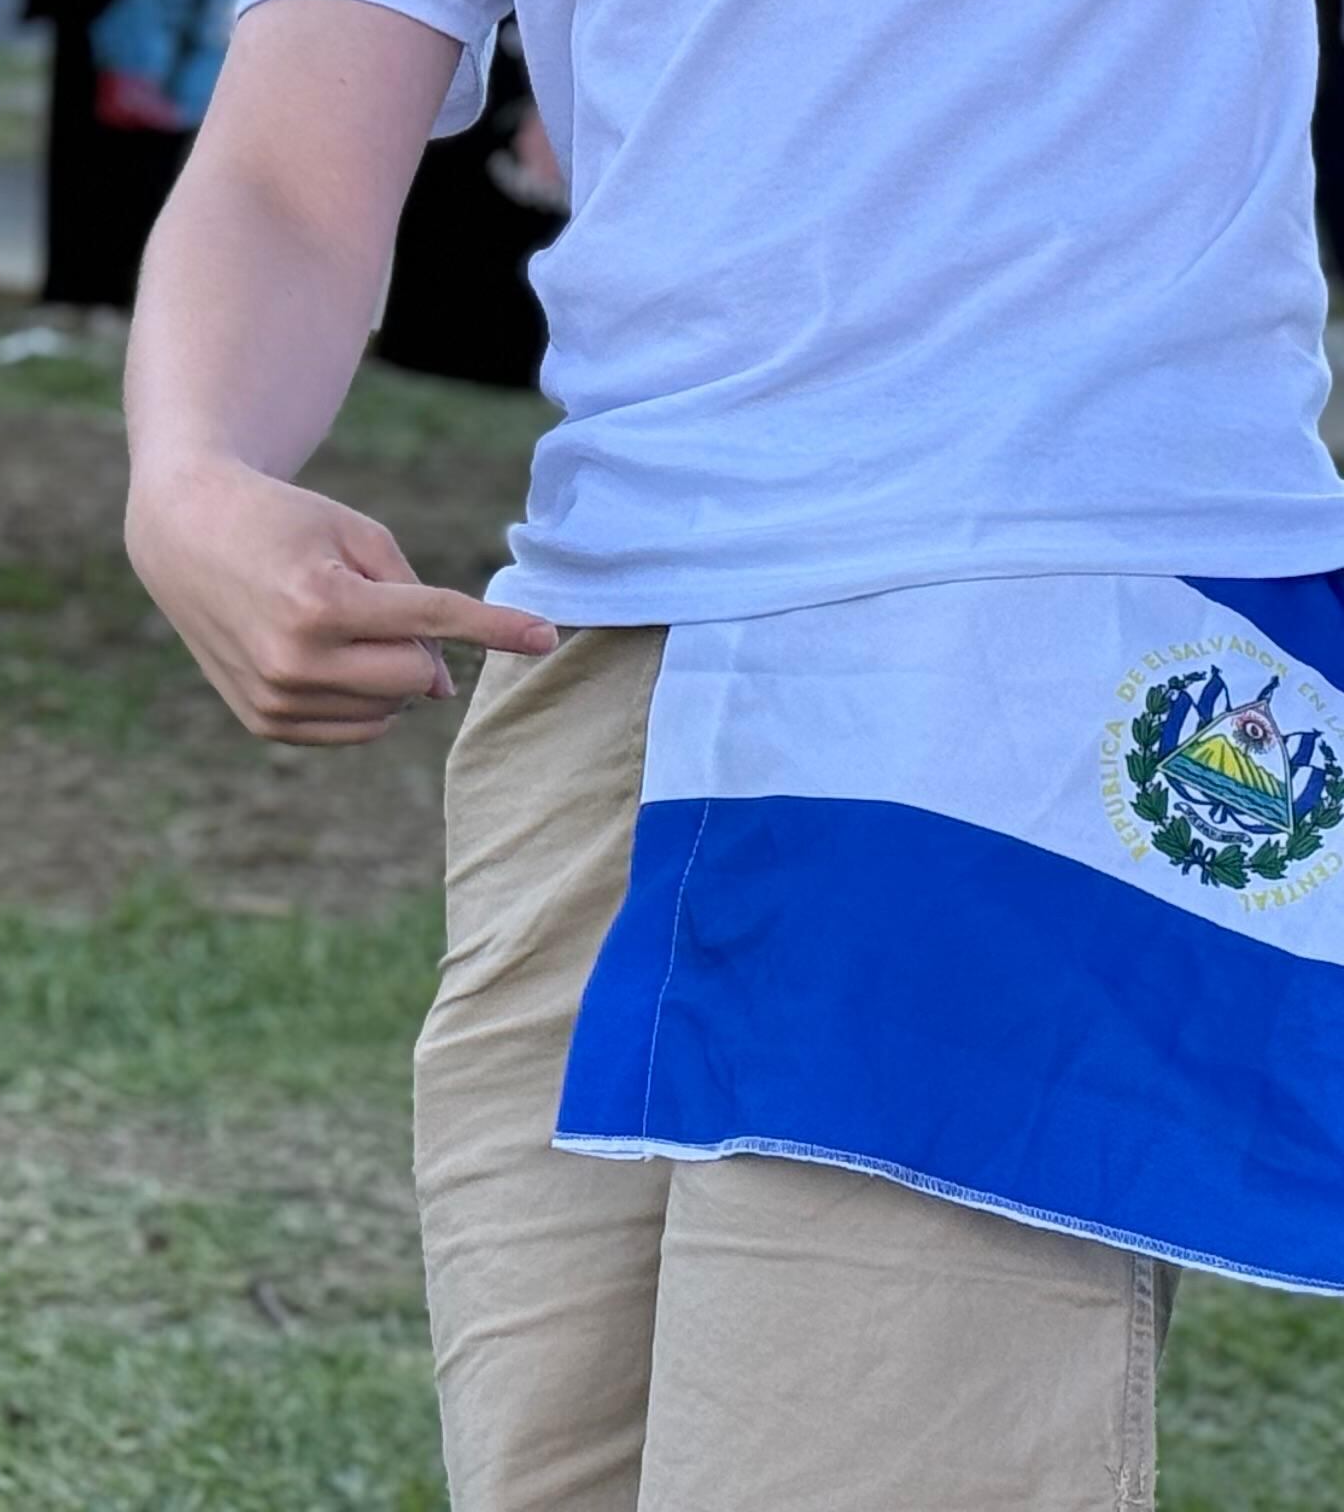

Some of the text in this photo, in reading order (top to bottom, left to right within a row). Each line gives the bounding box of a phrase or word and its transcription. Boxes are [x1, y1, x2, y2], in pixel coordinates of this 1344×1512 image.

[1115, 668, 1146, 703] DE
[1297, 682, 1328, 713] EN
[1238, 851, 1344, 913] CENTRAL
